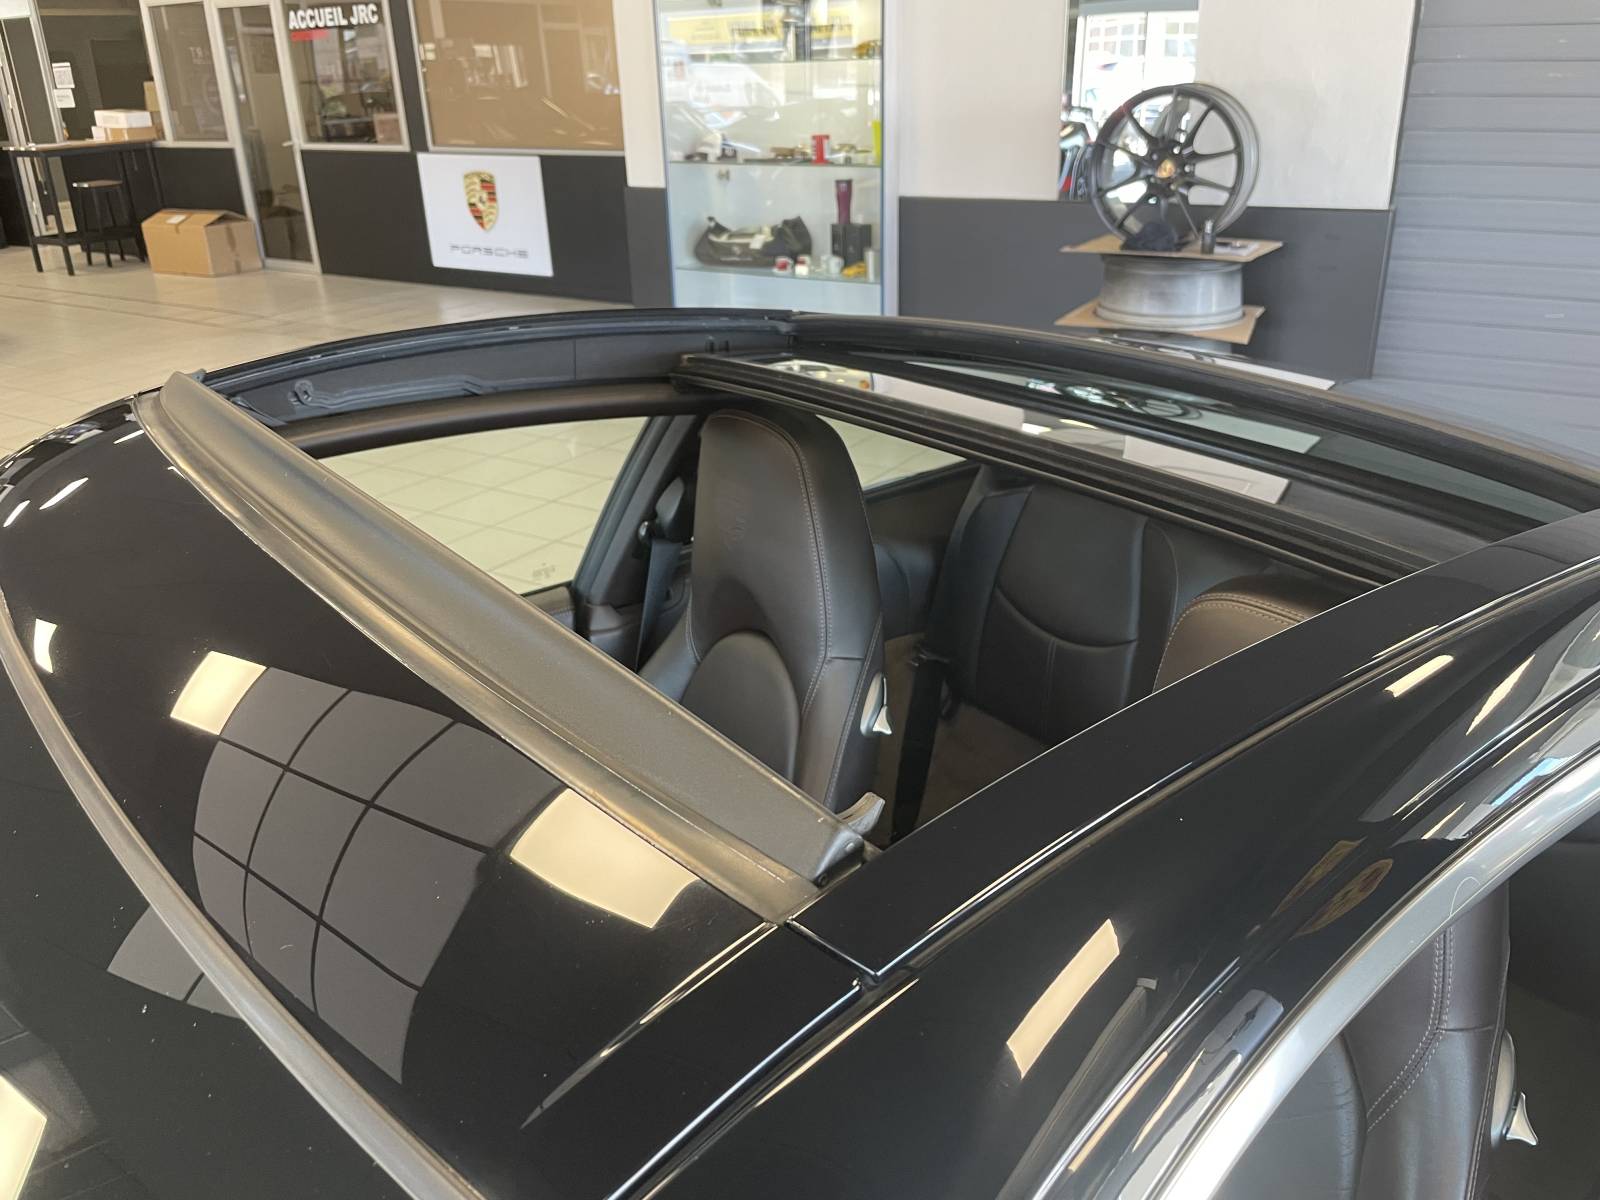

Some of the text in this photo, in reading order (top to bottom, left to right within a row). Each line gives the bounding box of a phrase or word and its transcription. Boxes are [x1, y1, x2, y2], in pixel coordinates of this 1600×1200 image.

[288, 3, 379, 29] ACCUEIL JRC
[449, 244, 529, 259] PORSCHE
